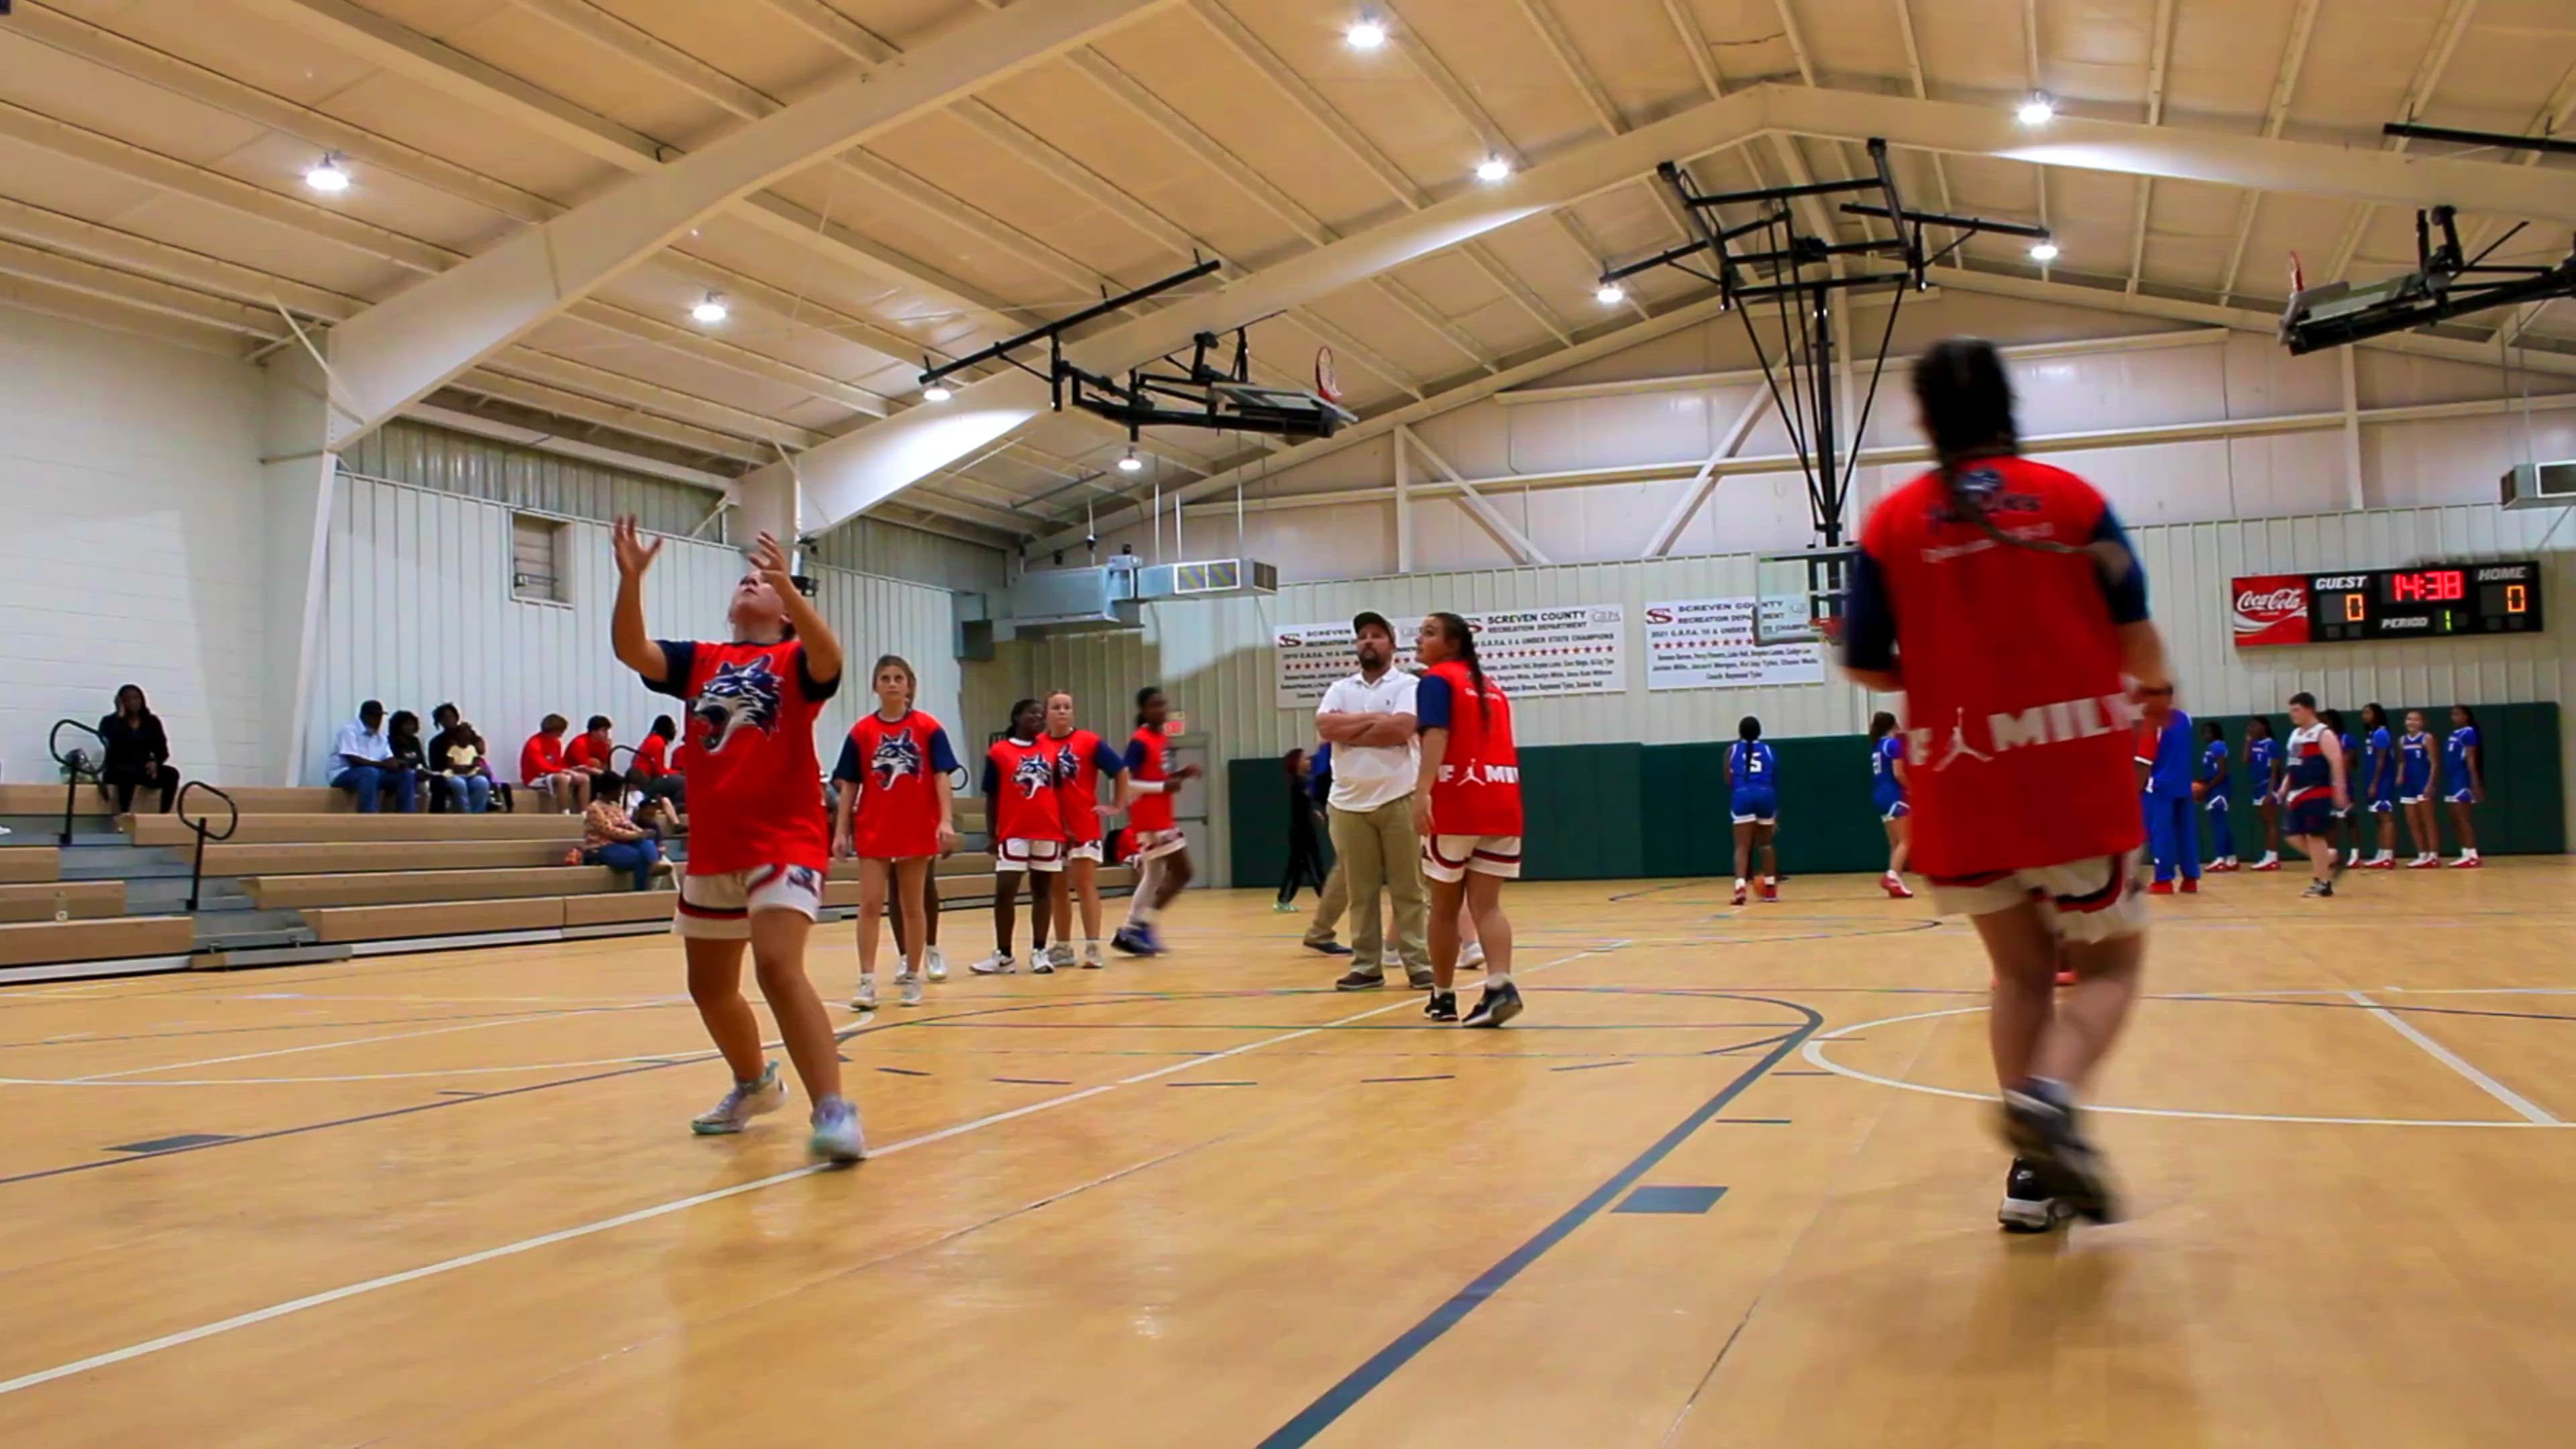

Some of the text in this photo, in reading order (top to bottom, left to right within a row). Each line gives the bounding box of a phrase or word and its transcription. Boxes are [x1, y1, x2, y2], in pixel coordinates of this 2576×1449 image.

[2479, 567, 2526, 580] HOME
[2316, 576, 2366, 590] GUEST
[2394, 571, 2462, 601] 14:38
[2507, 585, 2525, 612] 0
[2346, 594, 2364, 621] 0
[1488, 610, 1587, 624] SCREVEN COUNTY
[2381, 617, 2428, 629] PERIOD
[2445, 610, 2451, 630] 1
